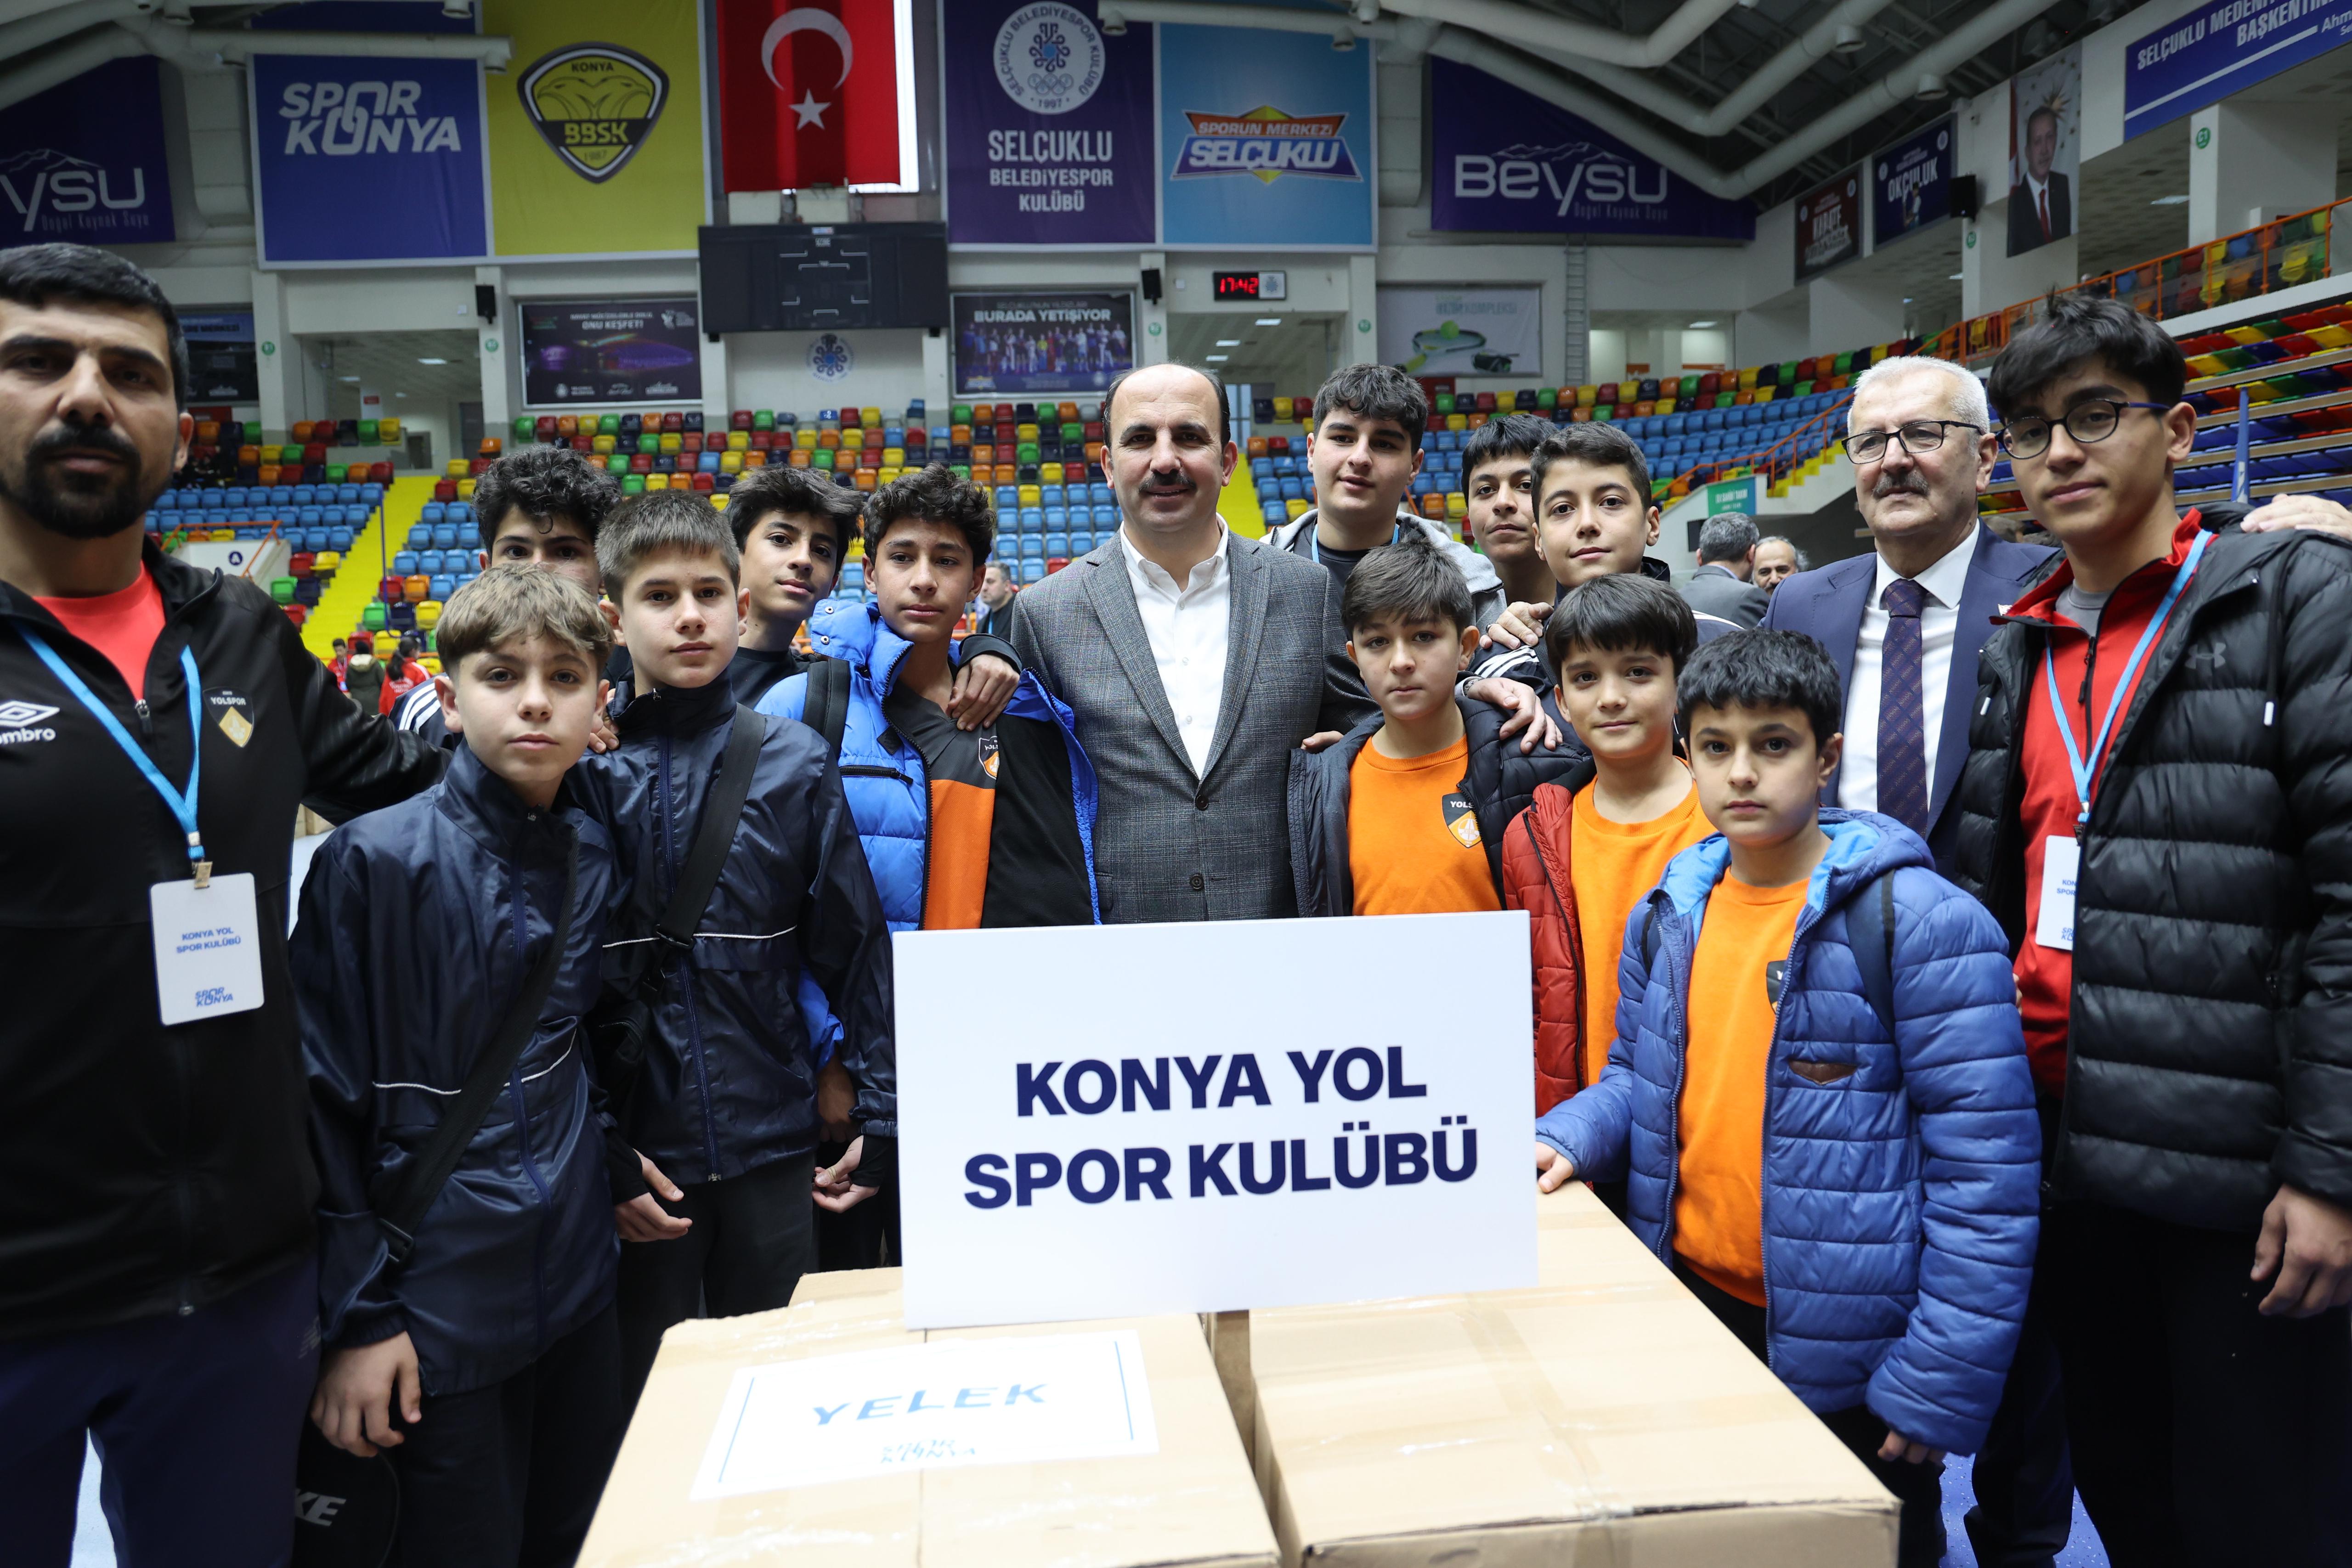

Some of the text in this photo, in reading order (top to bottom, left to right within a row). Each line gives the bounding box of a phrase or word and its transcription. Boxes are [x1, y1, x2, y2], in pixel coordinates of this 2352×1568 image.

[2137, 18, 2205, 70] SELÇUKLU
[571, 62, 613, 72] KONYA
[279, 80, 422, 134] SPOR
[284, 106, 461, 156] KONYA
[565, 121, 629, 144] BBSK
[1199, 122, 1334, 135] SPORUN MERKEZİ
[988, 129, 1113, 164] SELÇUKLU
[1191, 139, 1340, 170] SELÇUKLU
[989, 168, 1114, 187] BELEDİYESPOR
[1018, 189, 1086, 213] KULÜBÜ
[1220, 277, 1259, 294] 17:42
[973, 309, 1112, 324] BURADA YETİŞİYOR
[210, 696, 246, 705] YOLSPOR
[0, 727, 56, 745] mbro
[1450, 801, 1474, 809] YOLS
[176, 936, 241, 953] SPOR KULÜBÜ
[181, 927, 234, 941] KONYA YOL
[1016, 1046, 1428, 1117] KONYA YOL
[963, 1114, 1478, 1210] SPOR KULÜBÜ
[812, 1383, 1049, 1426] YELEK
[295, 1488, 347, 1527] KE
